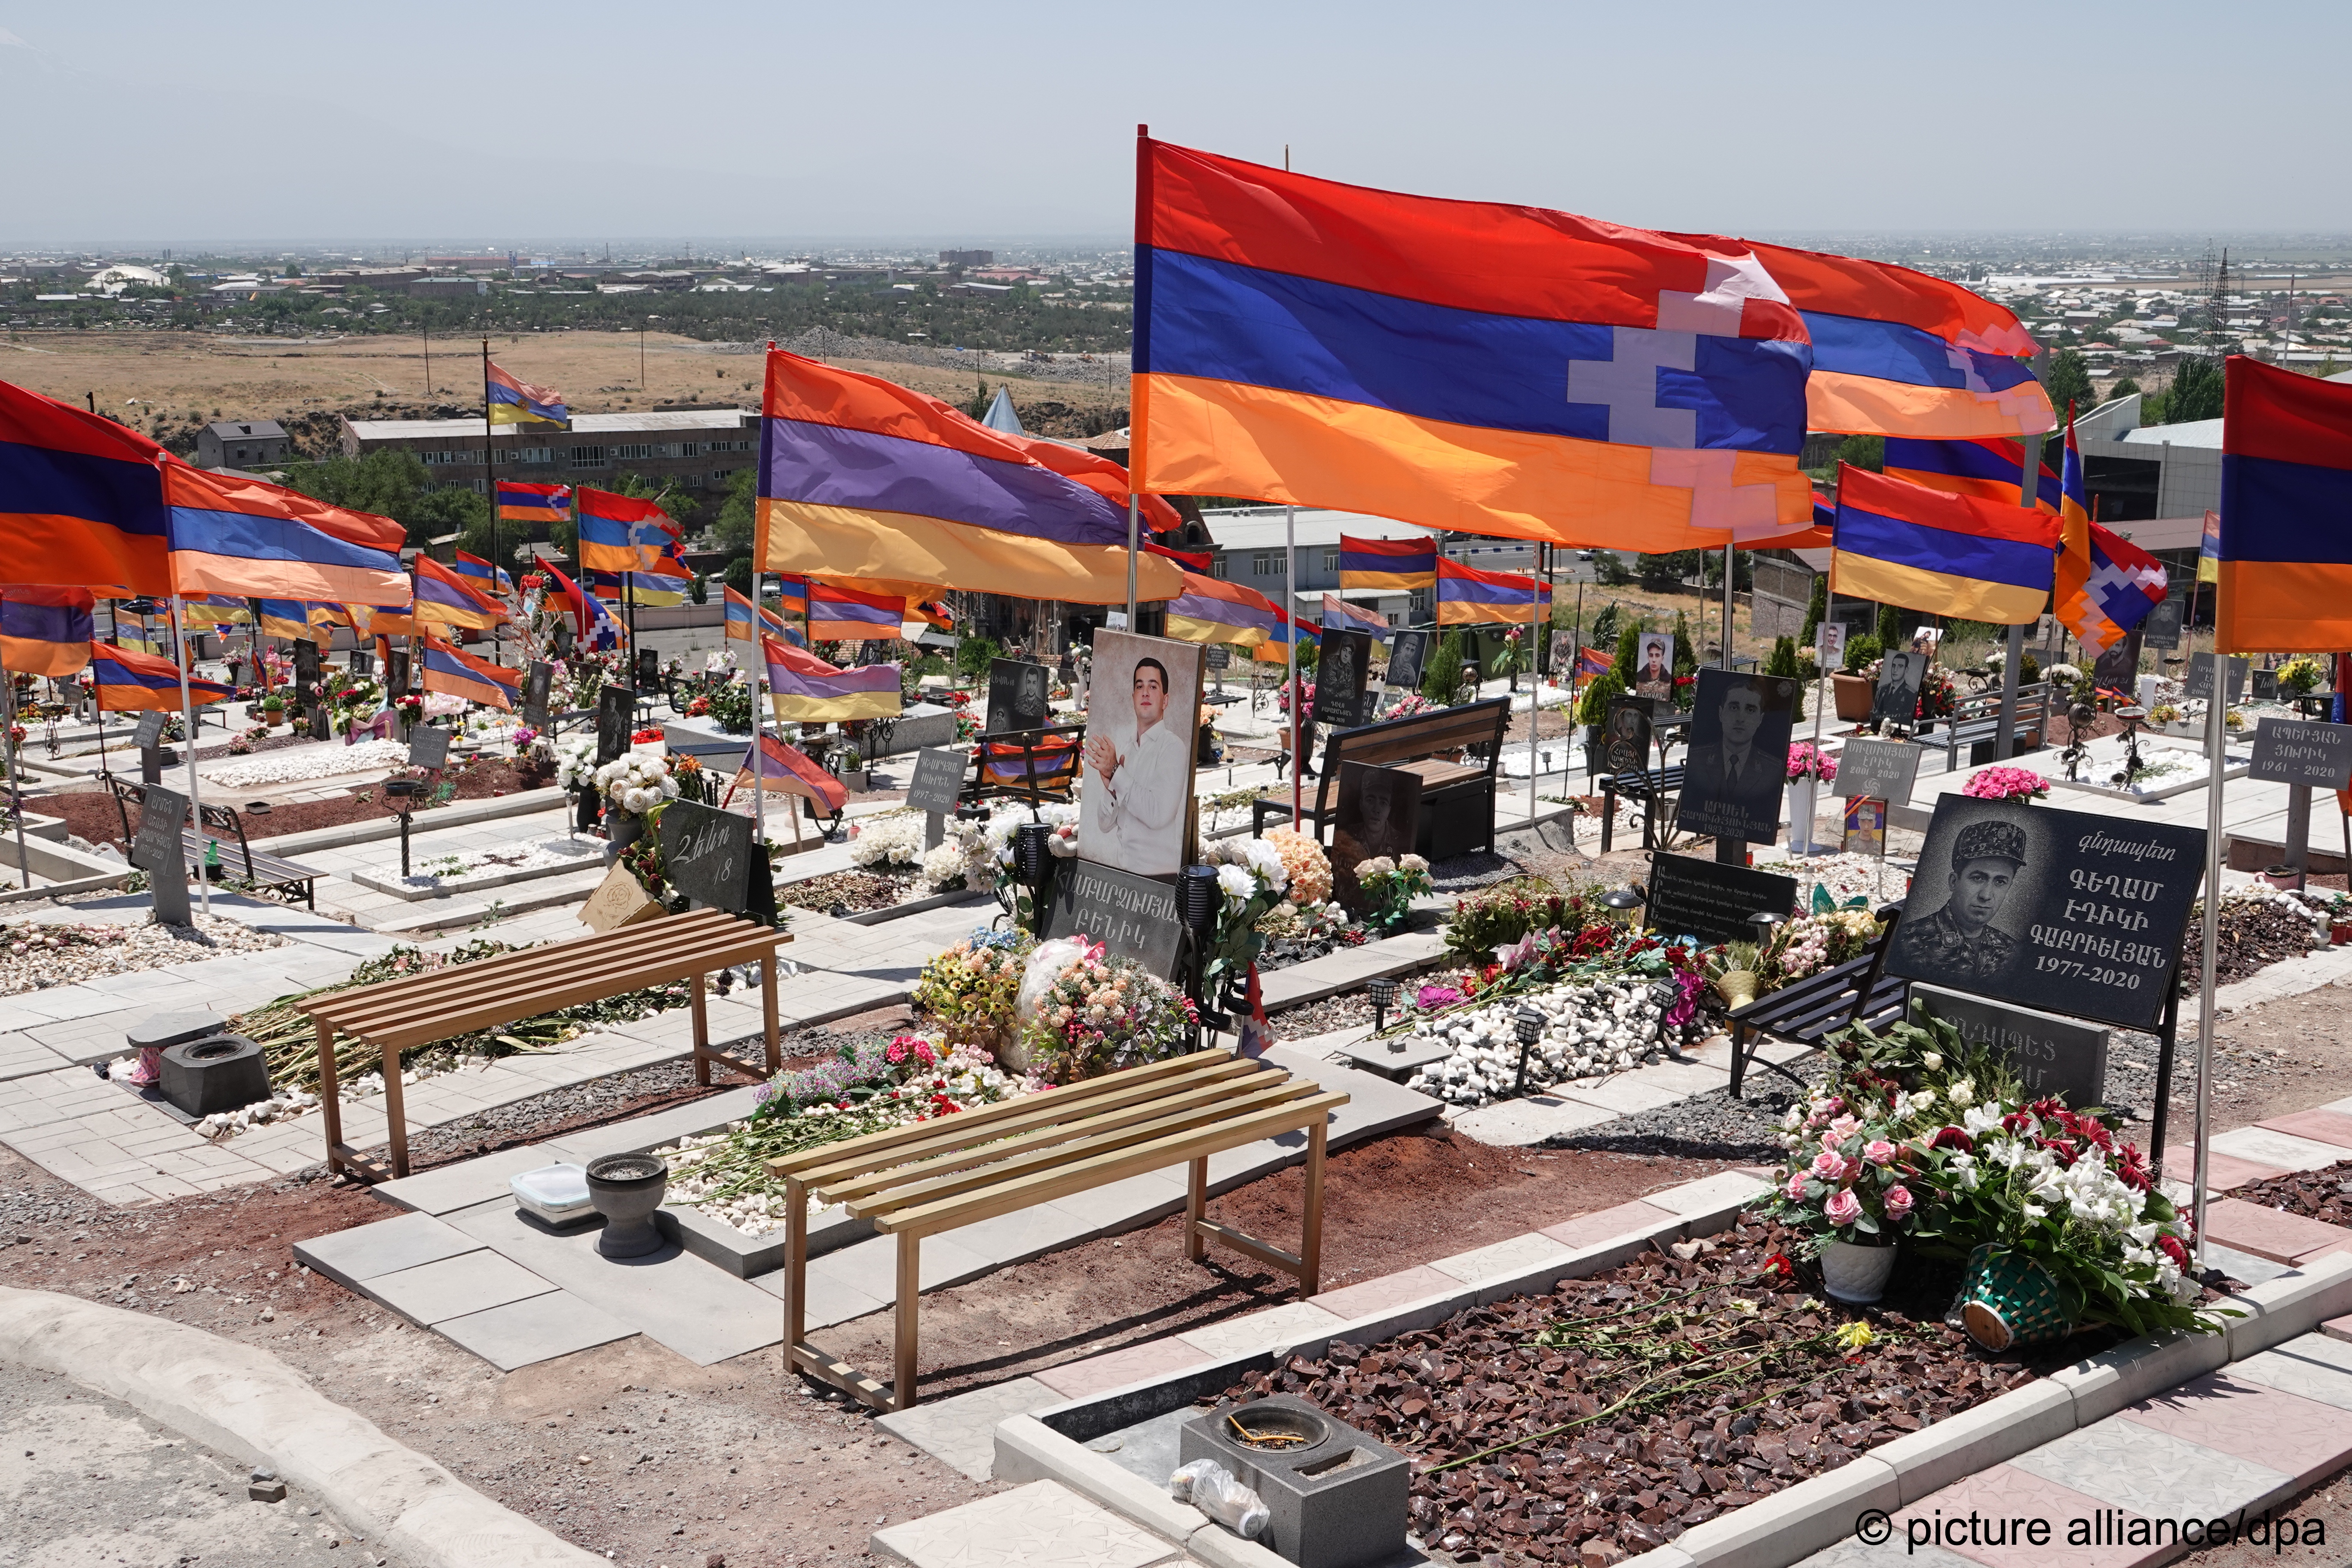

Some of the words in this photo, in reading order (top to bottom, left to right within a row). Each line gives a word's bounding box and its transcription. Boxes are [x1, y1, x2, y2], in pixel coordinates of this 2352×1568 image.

[991, 674, 1009, 686] ԼԵՎՈՆ
[2272, 726, 2341, 744] ԱՊԵՐՅԱՆ
[1849, 741, 1913, 759] ՄՈՎՍԻՍՅԱՆ
[921, 756, 959, 774] ԳԵՎՈՐԳՅԱՆ
[1862, 756, 1892, 769] ԷՐԻԿ
[2262, 760, 2287, 772] 1961
[2304, 765, 2335, 778] 2020
[1850, 766, 1869, 776] 2001
[1877, 769, 1899, 779] 2020
[151, 794, 172, 814] ԱՐՄԵՆ
[1704, 800, 1749, 818] ԱՐՍԵՆ
[147, 814, 168, 831] ԱՇՈՏԻ
[1704, 824, 1745, 838] 1983-2020
[138, 827, 172, 849] ԳԵՎՈՐԳՅԱՆ
[2079, 830, 2176, 862] գնդապետ
[712, 858, 732, 885] 18
[2070, 868, 2164, 902] ԳԵՂԱՄ
[2063, 898, 2149, 931] ԷԴԻԿԻ
[1075, 908, 1145, 949] ԲԵՆԻԿ
[2030, 924, 2166, 969] ԳԱԲՐԻԵԼՅԱՆ
[2035, 956, 2141, 990] 1977-2020
